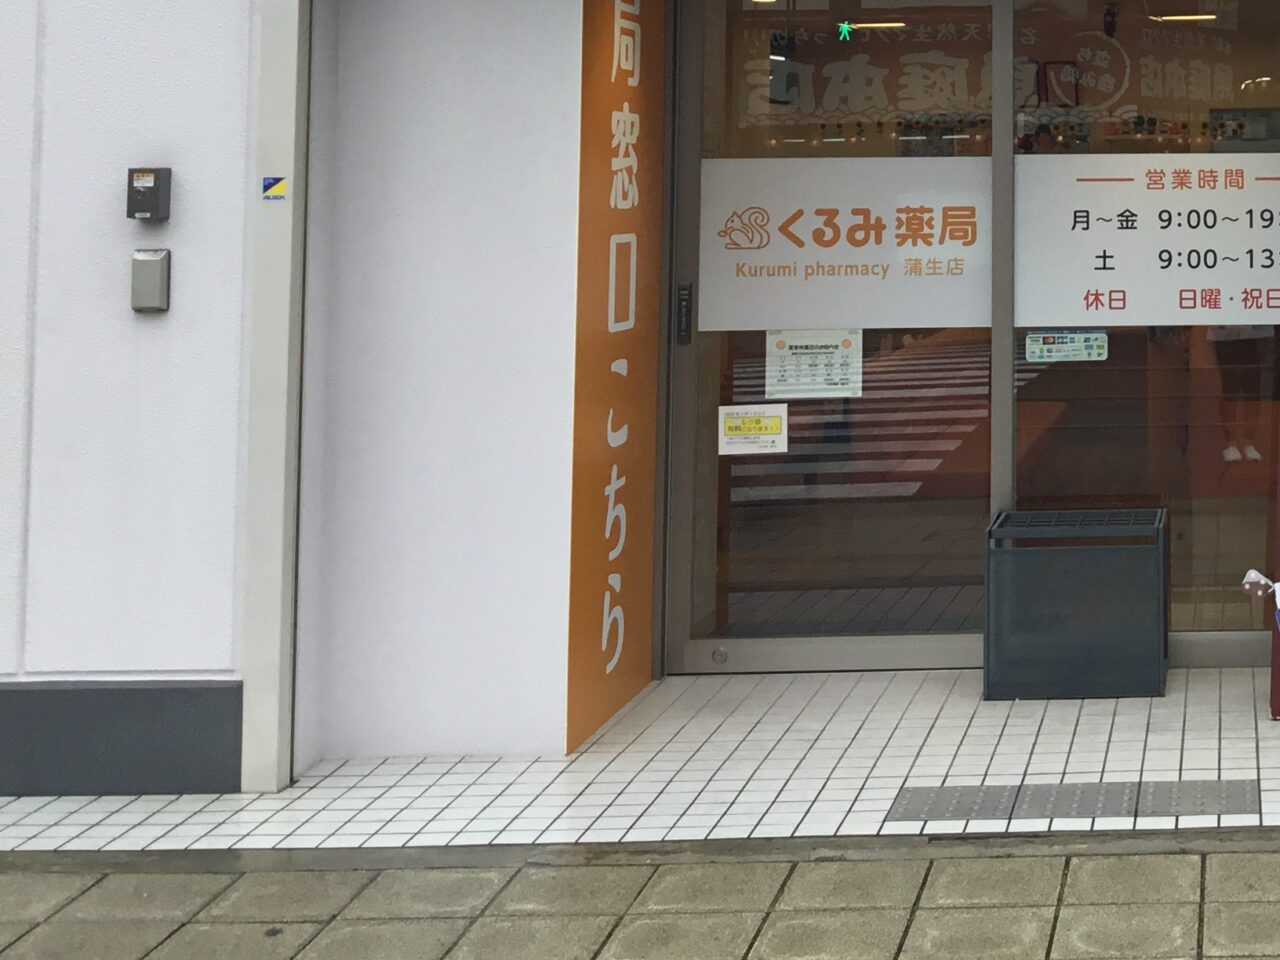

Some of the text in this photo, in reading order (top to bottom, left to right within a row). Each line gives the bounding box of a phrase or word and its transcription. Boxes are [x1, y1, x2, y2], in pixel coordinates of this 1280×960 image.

[1145, 168, 1245, 190] 営業時間
[778, 205, 978, 248] くるみ薬局
[736, 257, 965, 280] Kurumi pharmacy 蒲生店
[1094, 249, 1115, 271] 土
[1083, 289, 1127, 311] 休日
